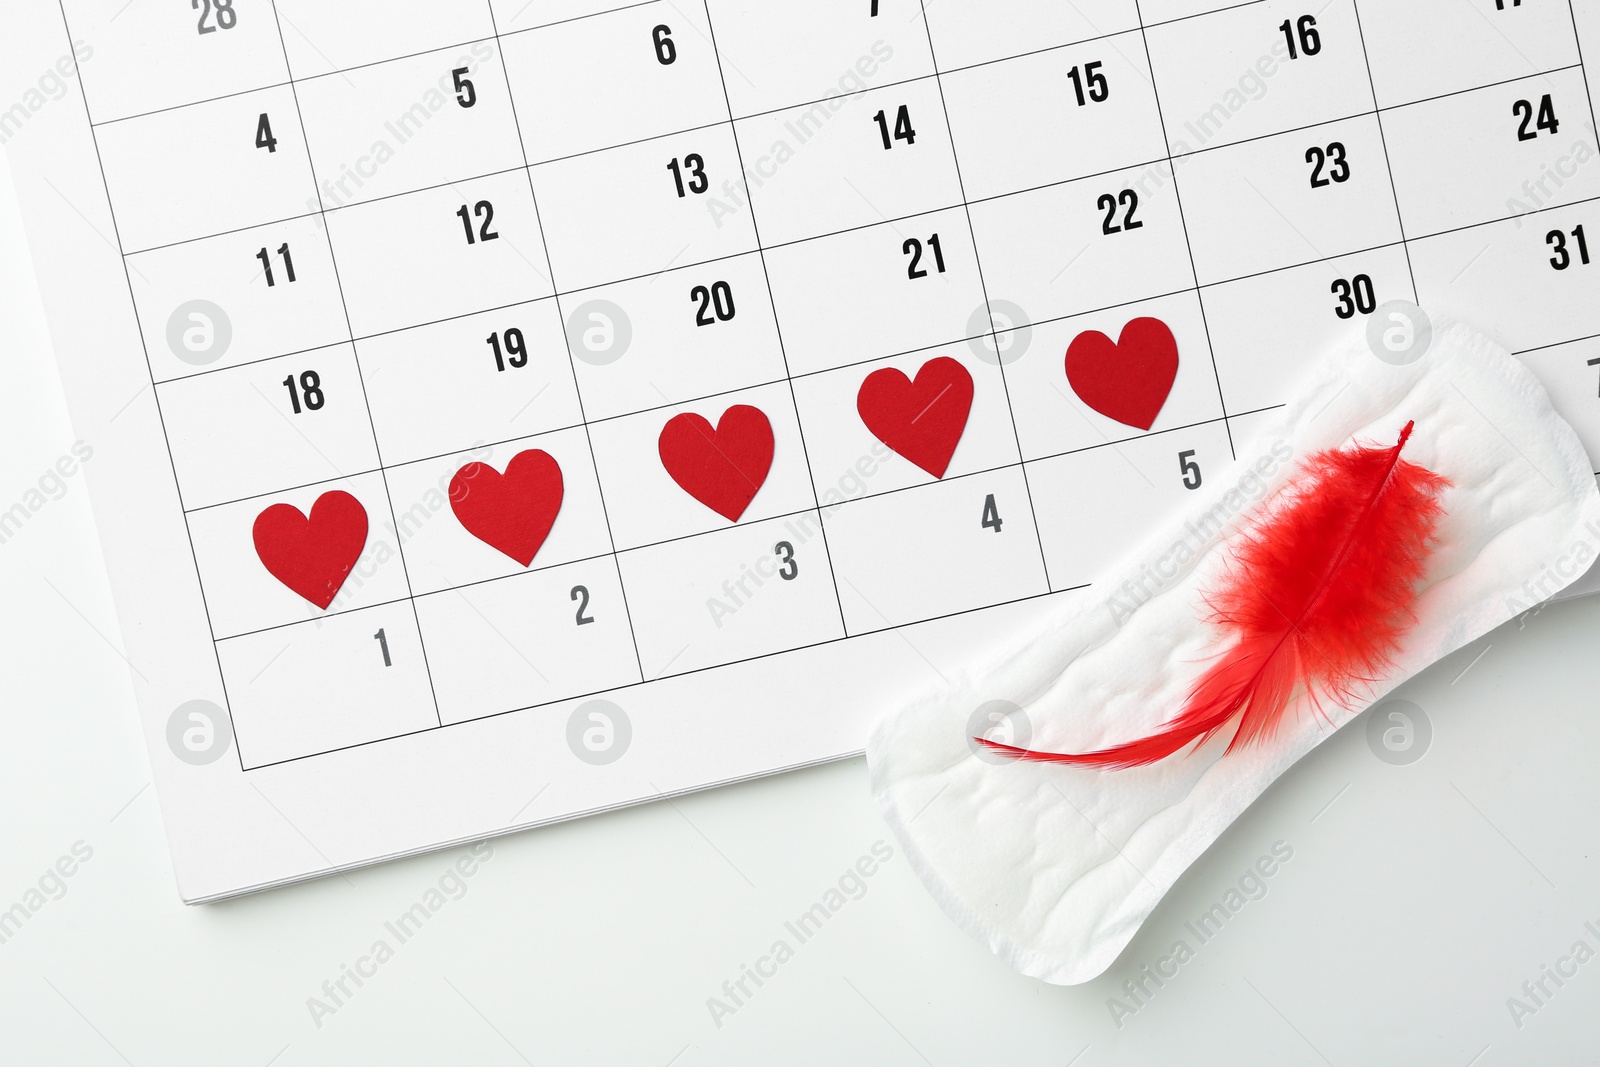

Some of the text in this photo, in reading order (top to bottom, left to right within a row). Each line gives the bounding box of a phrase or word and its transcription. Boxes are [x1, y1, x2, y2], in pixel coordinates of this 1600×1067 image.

[192, 0, 236, 34] 28
[1279, 15, 1321, 60] 16
[652, 25, 676, 65] 6
[452, 67, 476, 108] 5
[1067, 61, 1108, 106] 15
[256, 113, 277, 153] 4
[873, 105, 916, 150] 14
[1513, 94, 1559, 141] 24
[667, 153, 708, 198] 13
[1305, 142, 1350, 188] 23
[457, 200, 499, 244] 12
[1097, 189, 1143, 235] 22
[256, 243, 296, 287] 11
[903, 233, 945, 280] 21
[1546, 224, 1590, 270] 31
[691, 281, 735, 327] 20
[1331, 274, 1376, 319] 30
[487, 328, 527, 372] 19
[283, 370, 324, 414] 18
[1178, 450, 1202, 490] 5
[982, 494, 1003, 533] 4
[775, 541, 798, 580] 3
[571, 585, 594, 625] 2
[374, 628, 391, 667] 1
